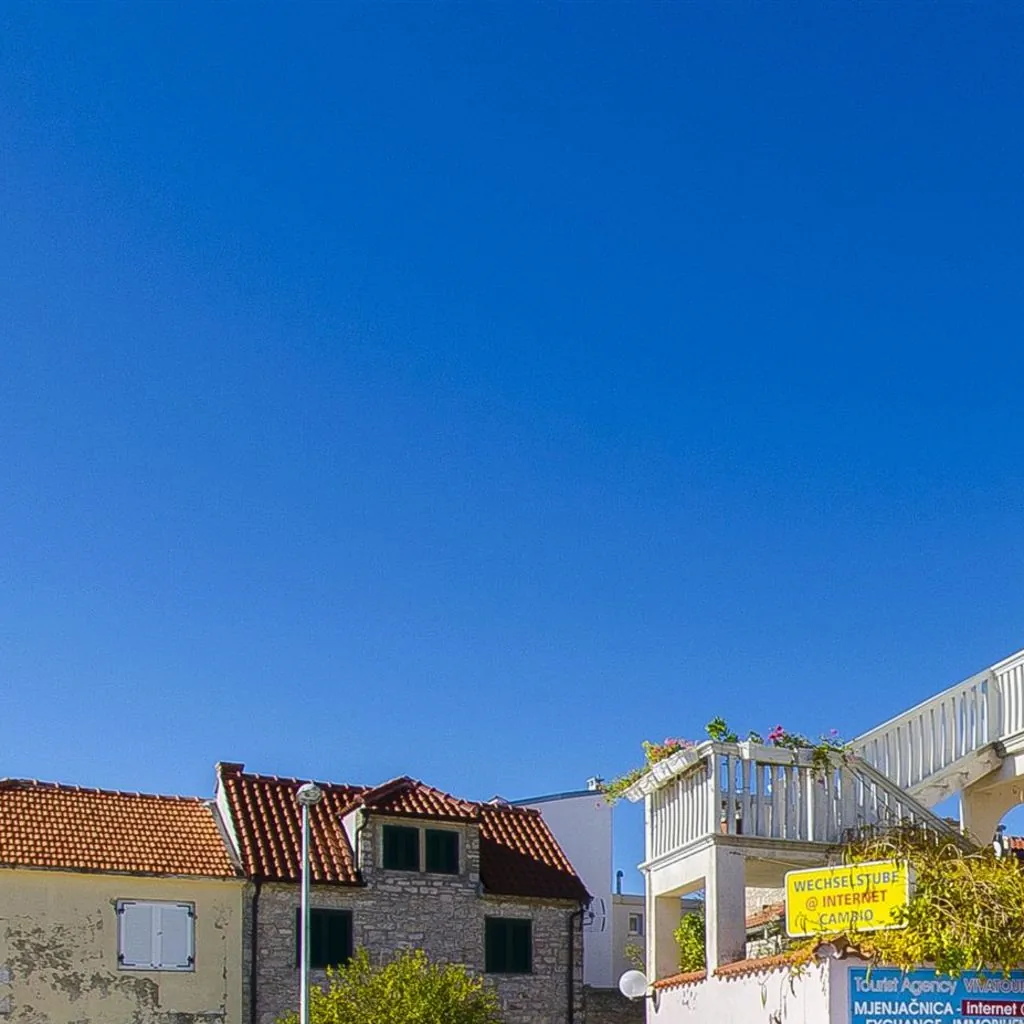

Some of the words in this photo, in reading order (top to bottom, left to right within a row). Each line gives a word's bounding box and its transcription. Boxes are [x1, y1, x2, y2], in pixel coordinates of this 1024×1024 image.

[794, 871, 899, 892] WECHSELSTUBE
[806, 896, 818, 911] @
[822, 890, 887, 907] INTERNET
[819, 909, 874, 926] CAMBIO
[854, 976, 899, 993] Tourist
[901, 977, 958, 995] Agency
[854, 998, 954, 1015] MJENJAČNICA
[966, 1001, 1017, 1016] internet
